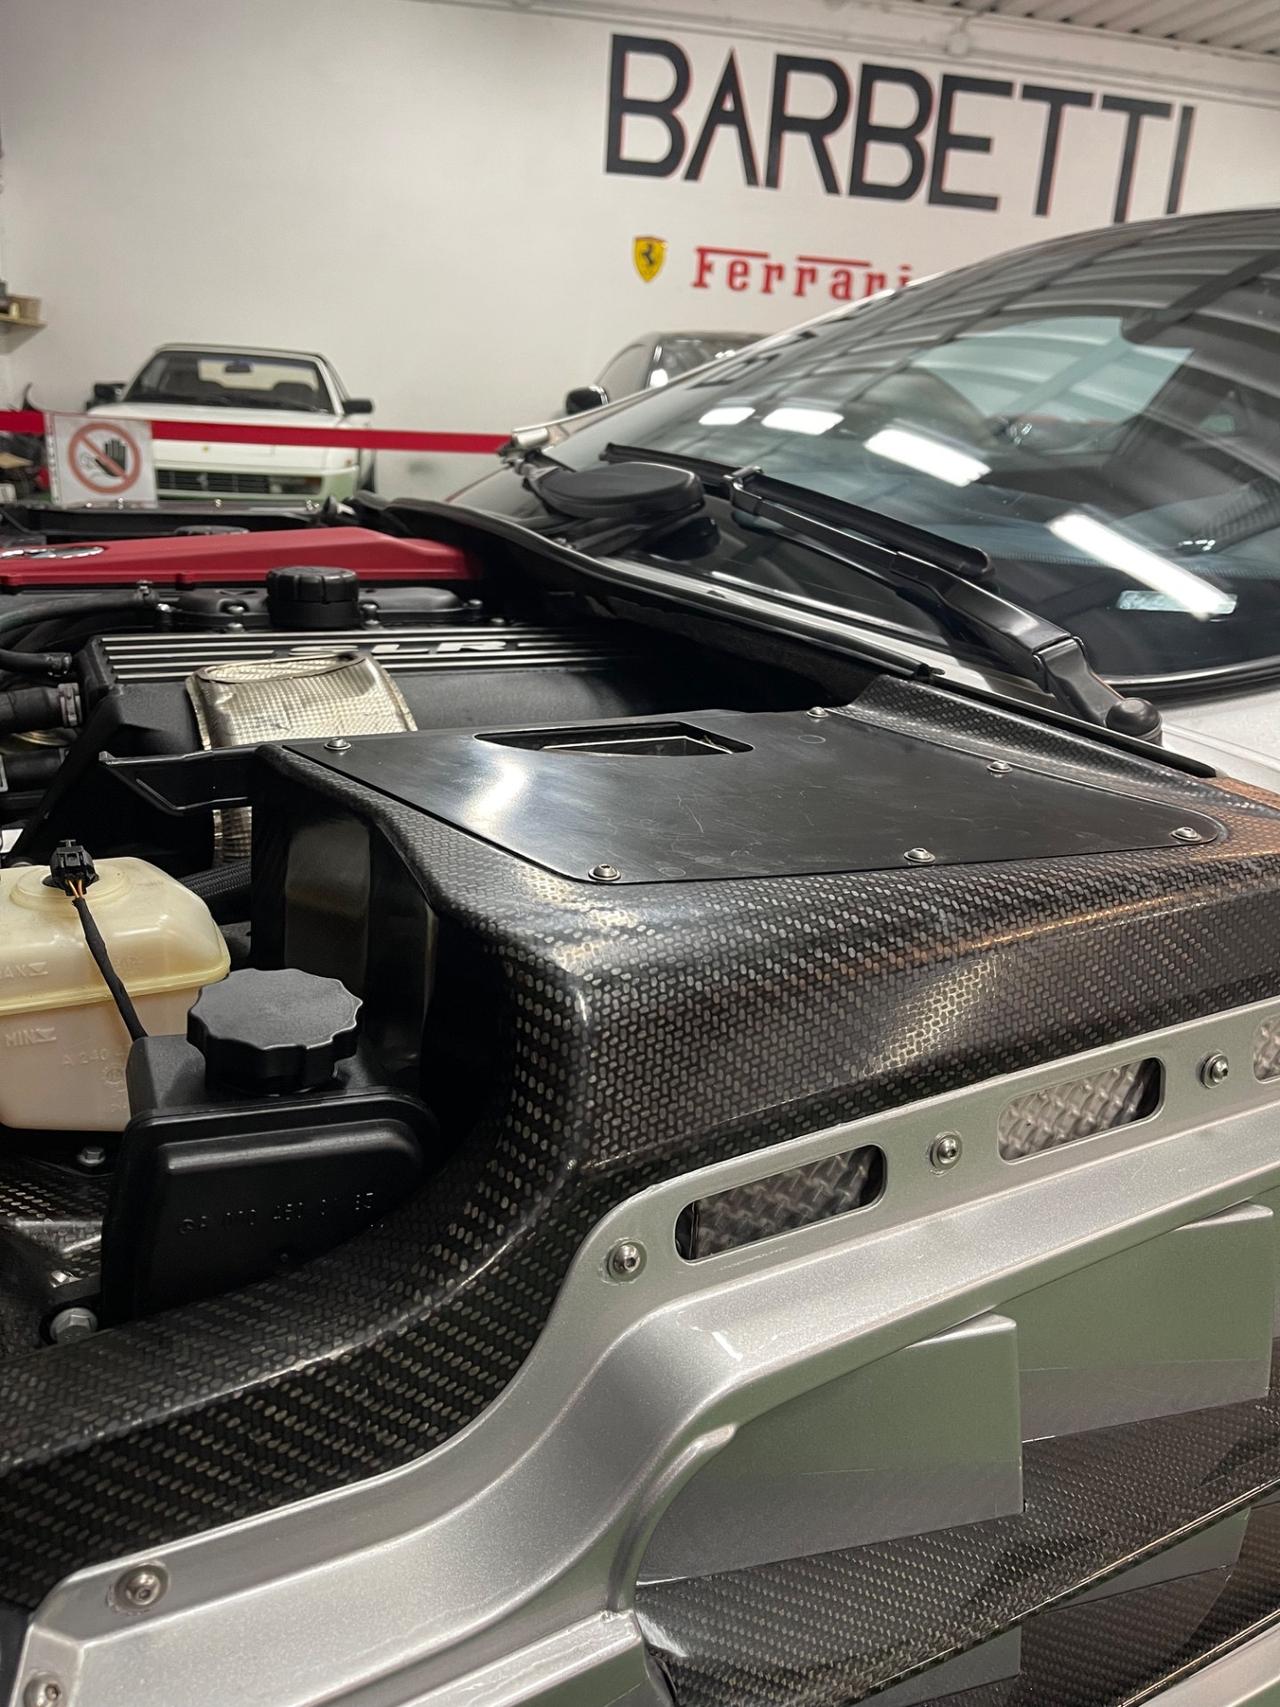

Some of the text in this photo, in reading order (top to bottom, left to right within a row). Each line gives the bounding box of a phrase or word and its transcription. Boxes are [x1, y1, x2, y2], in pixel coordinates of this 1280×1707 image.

[605, 33, 1195, 223] BARBETTI
[692, 246, 912, 300] Ferrari
[4, 1027, 34, 1047] MIN
